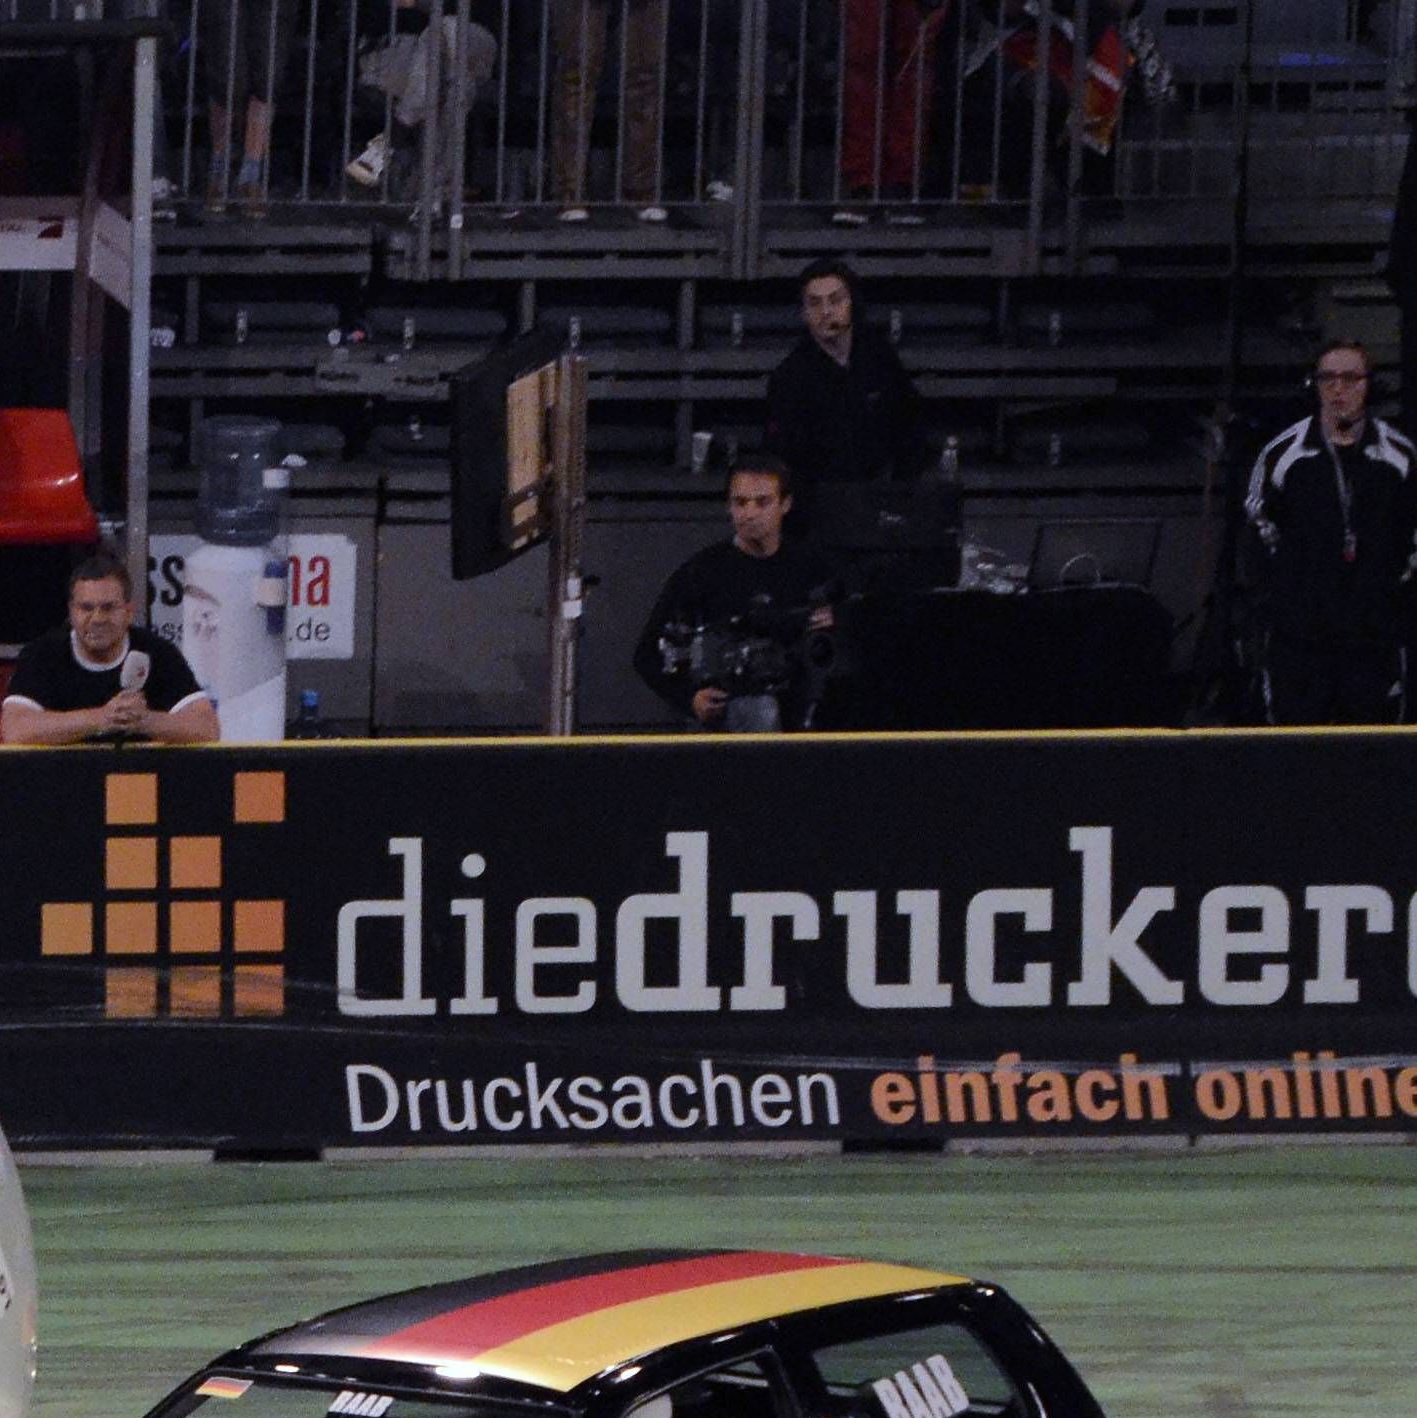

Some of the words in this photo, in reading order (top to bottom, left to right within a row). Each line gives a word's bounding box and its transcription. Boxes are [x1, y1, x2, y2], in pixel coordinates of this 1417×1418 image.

[337, 826, 1417, 1016] diedrucker
[346, 1058, 841, 1133] Drucksachen
[870, 1052, 1171, 1125] einfach
